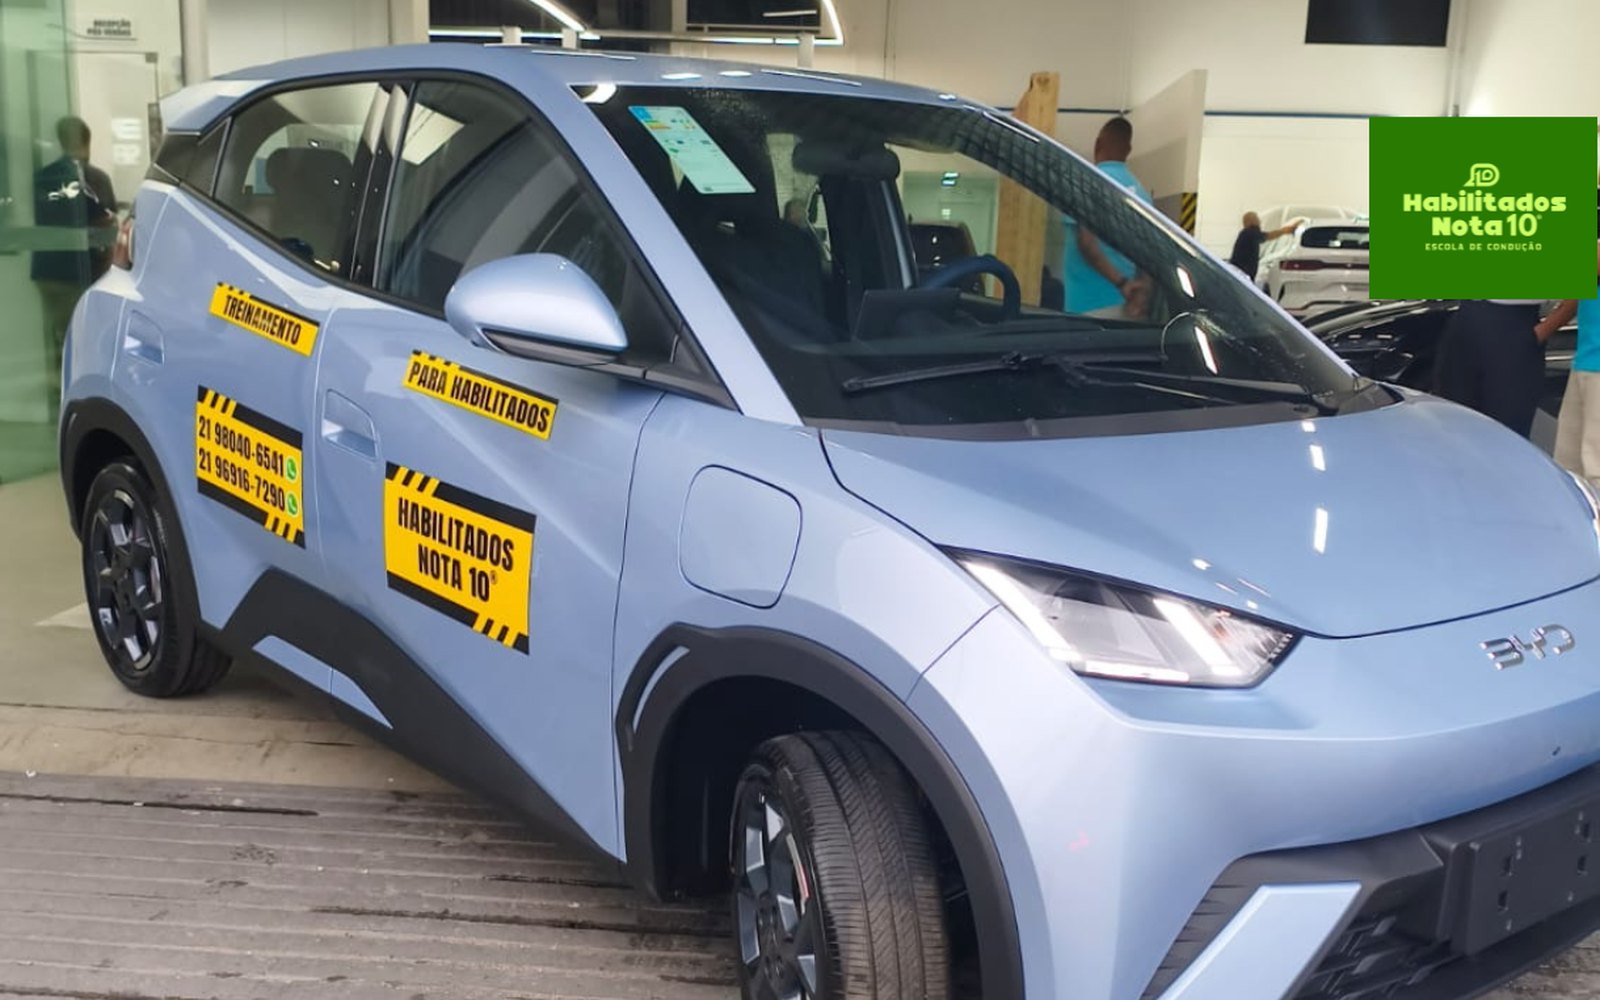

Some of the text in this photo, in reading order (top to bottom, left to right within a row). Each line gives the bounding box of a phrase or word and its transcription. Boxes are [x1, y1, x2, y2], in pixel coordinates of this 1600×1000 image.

[223, 294, 302, 346] TREINAMENTO
[408, 360, 551, 434] PARA HABILITADOS
[198, 415, 285, 478] 21 98040-6541
[198, 447, 286, 512] 21 96916-7290
[397, 496, 515, 573] HABILITADOS
[417, 543, 462, 591] NOTA
[1479, 623, 1576, 672] BYD
